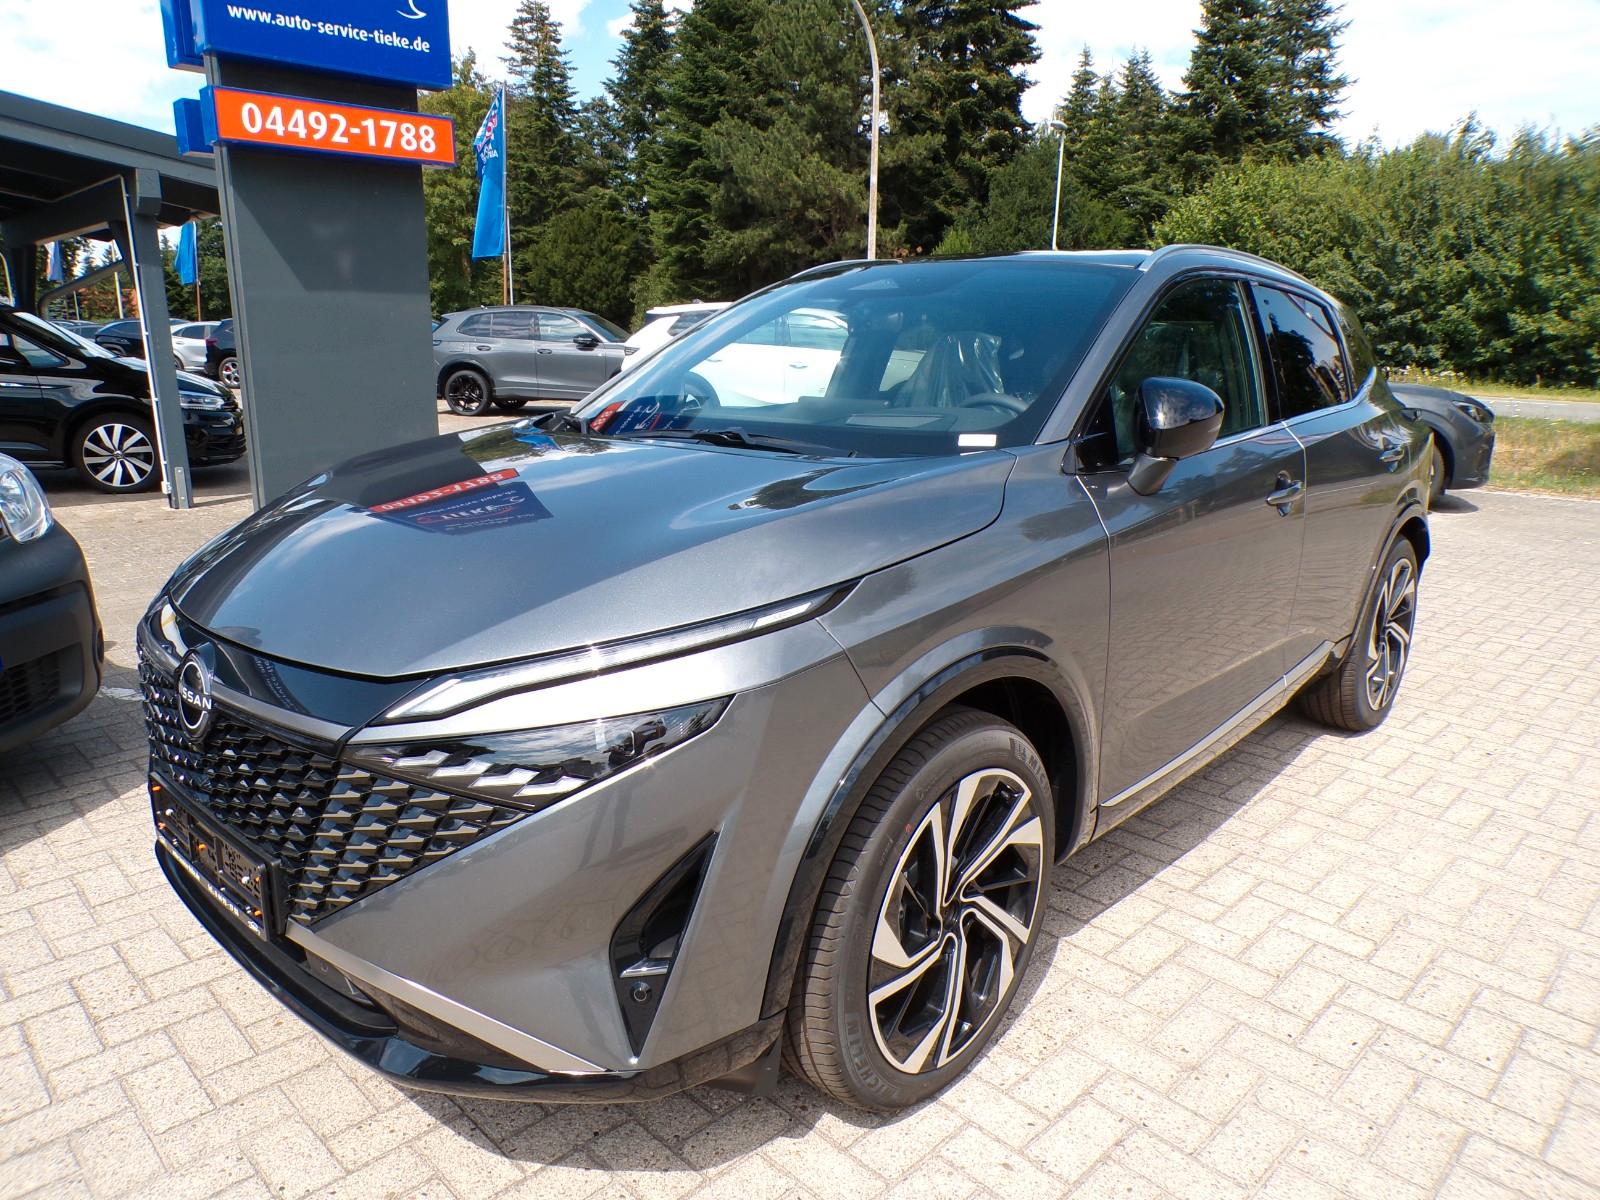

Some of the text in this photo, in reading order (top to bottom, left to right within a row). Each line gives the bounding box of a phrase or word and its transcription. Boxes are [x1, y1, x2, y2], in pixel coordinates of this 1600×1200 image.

[226, 4, 430, 53] www.auto-service-tieke.de
[241, 102, 437, 153] 04492-1788
[180, 687, 212, 710] SSAN
